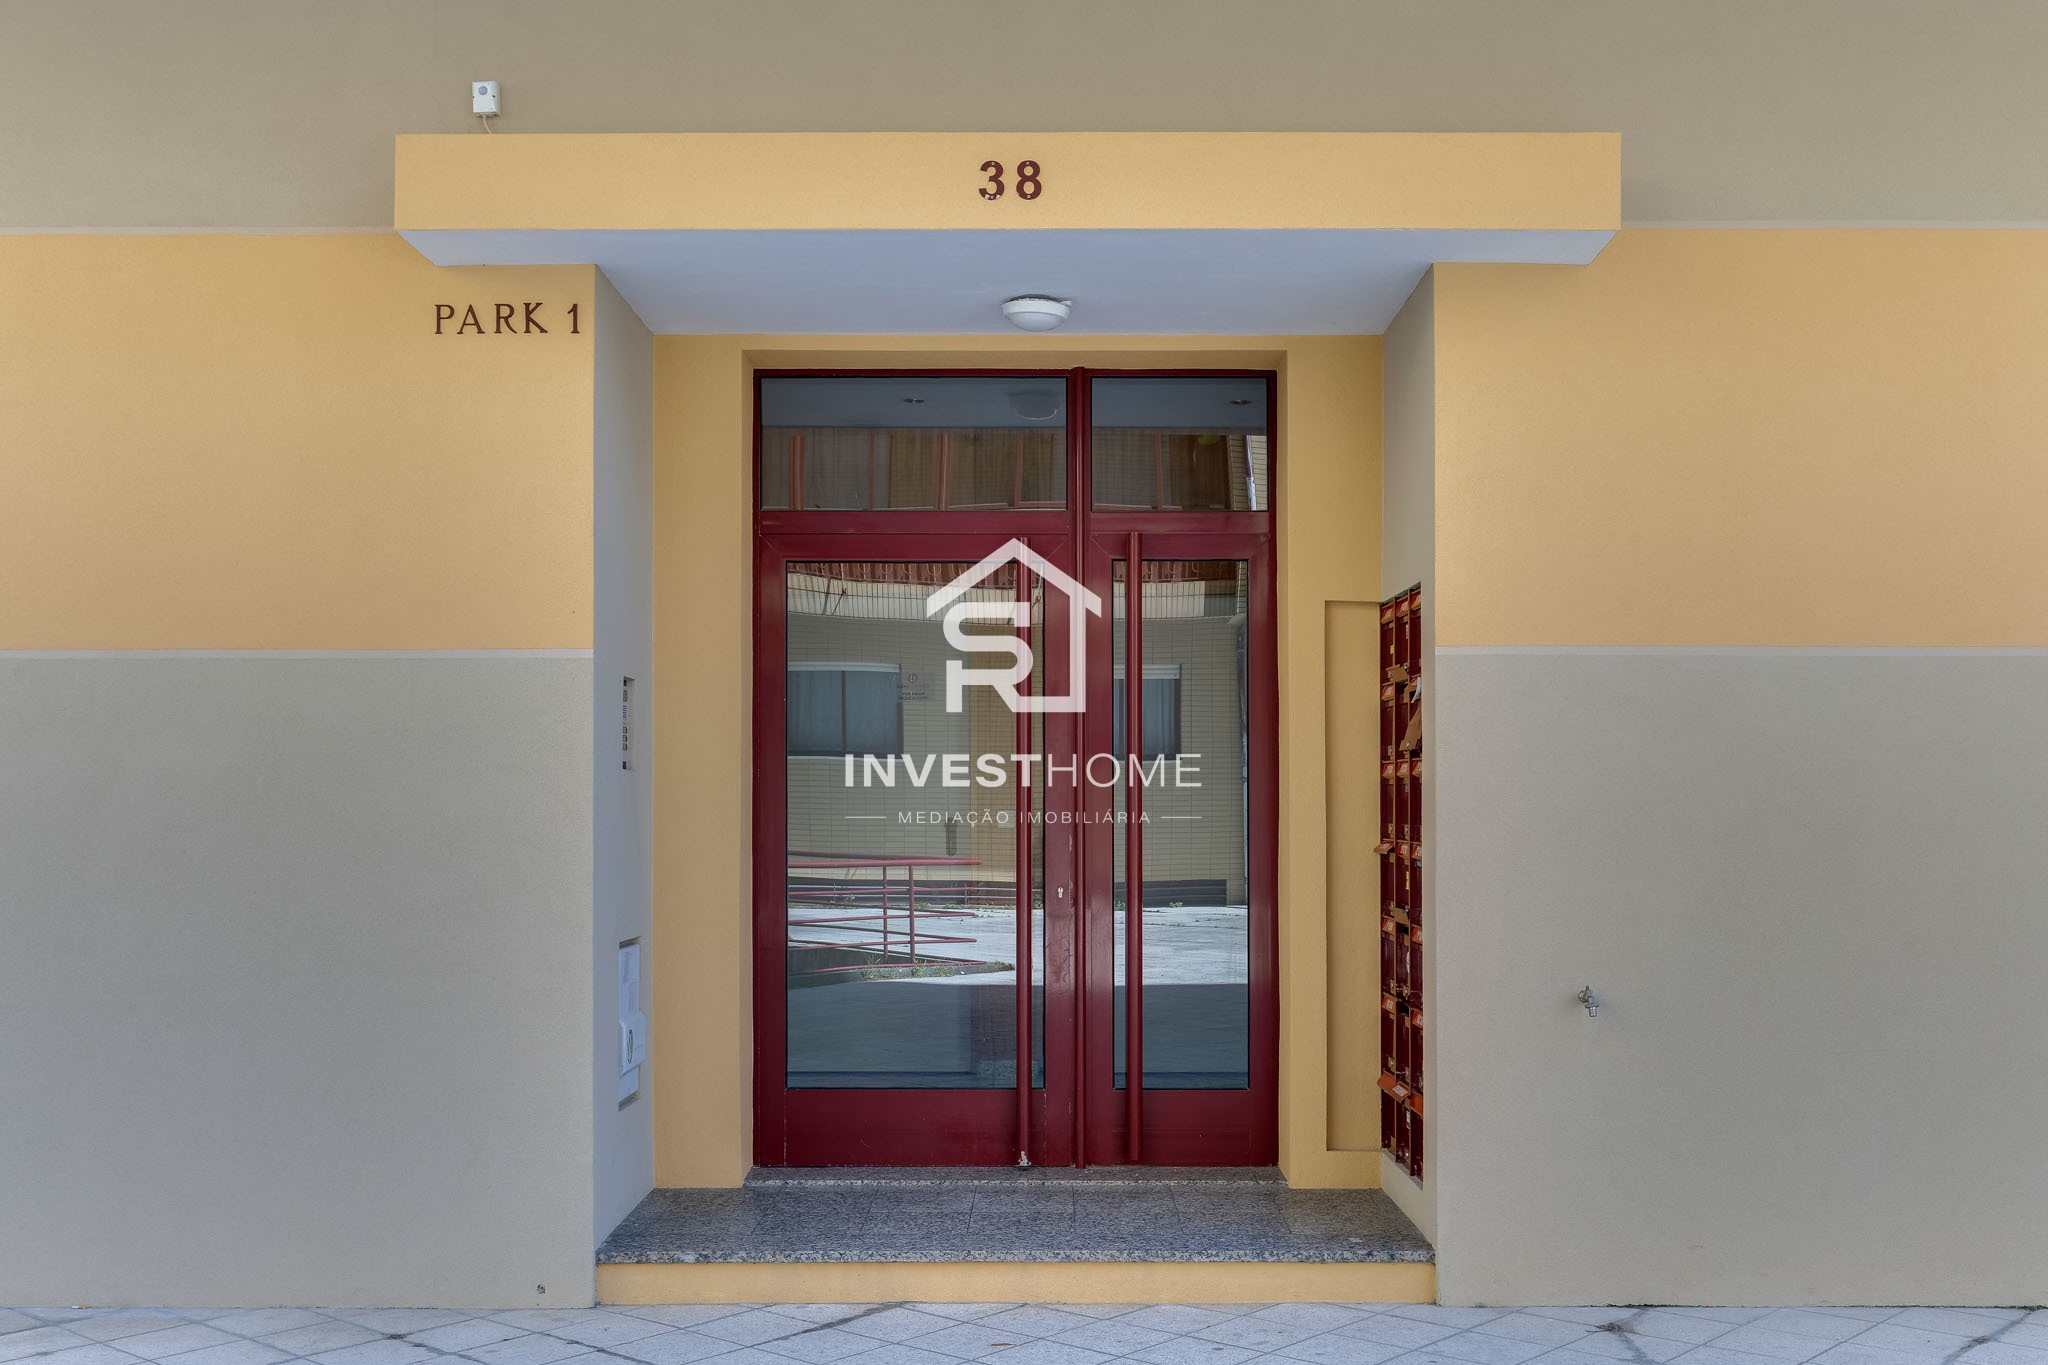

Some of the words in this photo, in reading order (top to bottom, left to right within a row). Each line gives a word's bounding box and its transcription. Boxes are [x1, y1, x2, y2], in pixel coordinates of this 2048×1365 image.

[978, 160, 1042, 201] 38
[434, 302, 549, 335] PARK
[567, 303, 581, 335] 1
